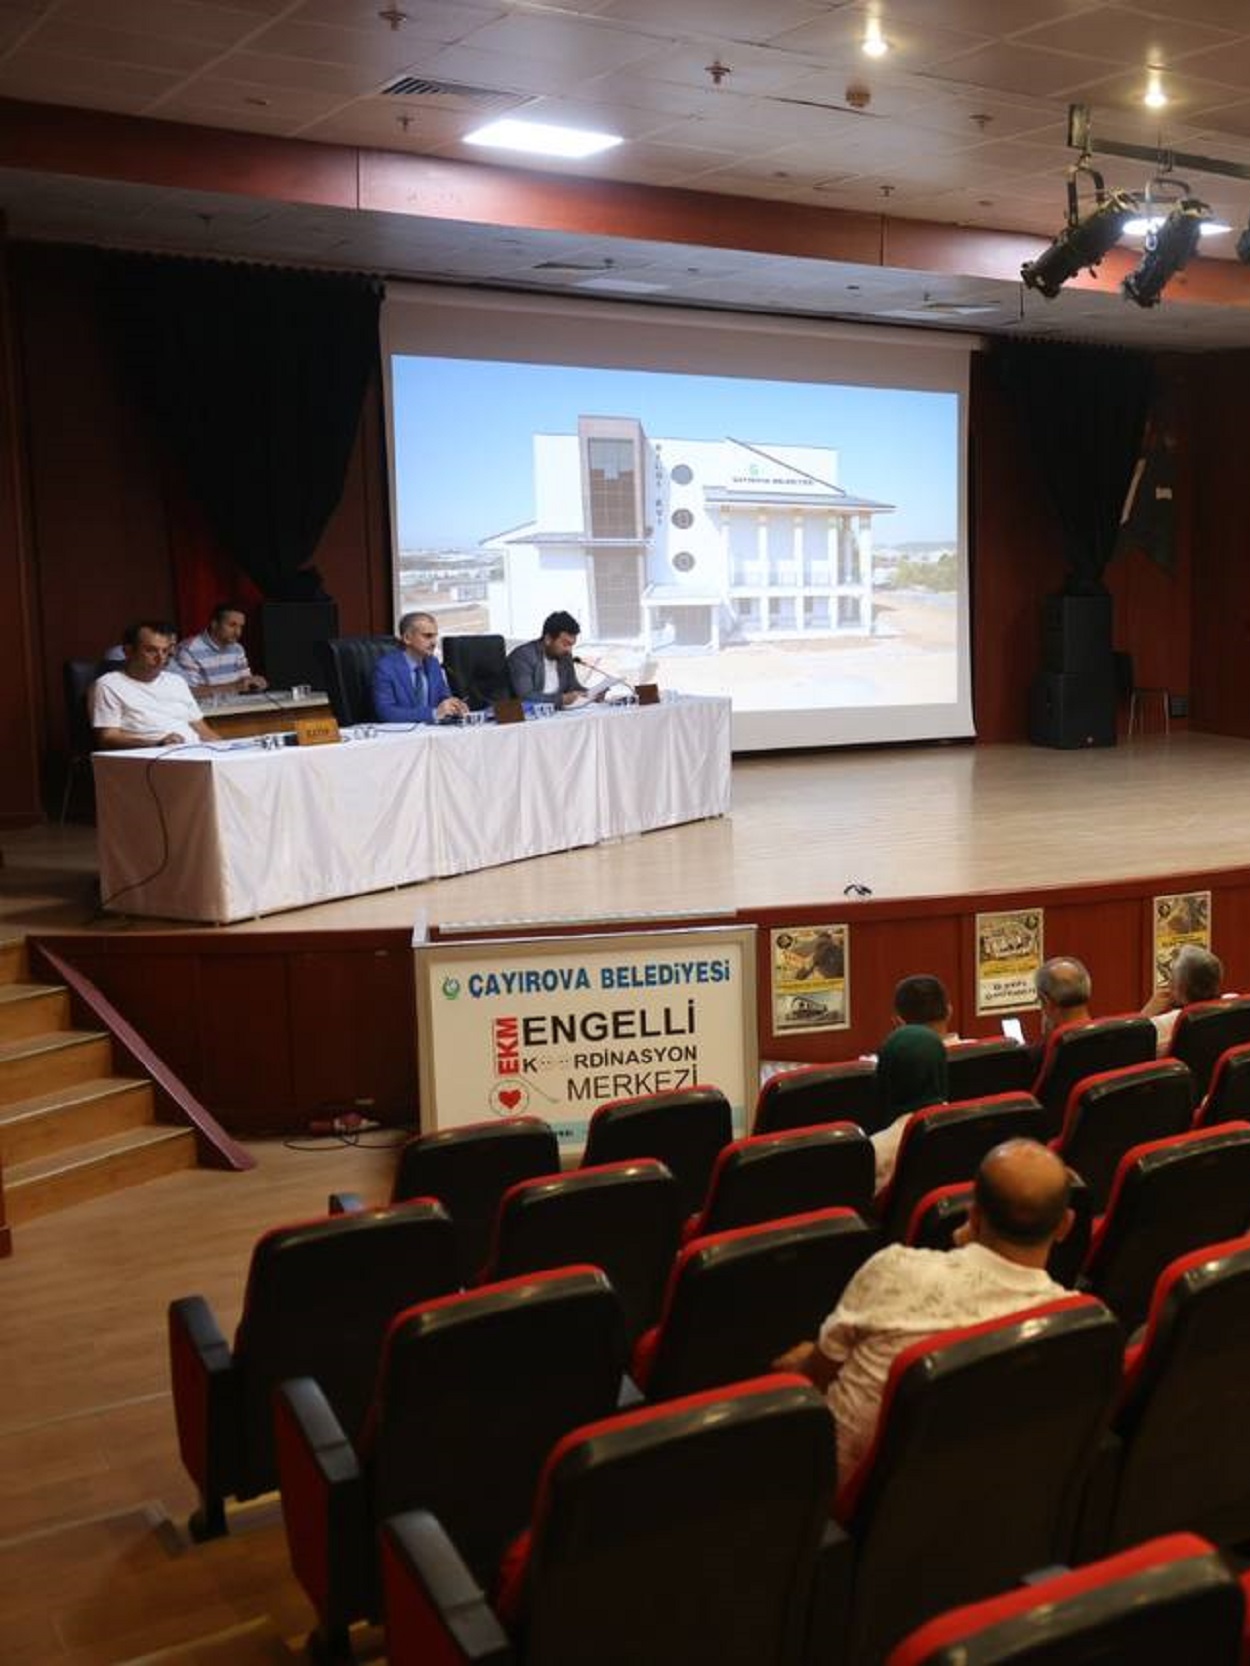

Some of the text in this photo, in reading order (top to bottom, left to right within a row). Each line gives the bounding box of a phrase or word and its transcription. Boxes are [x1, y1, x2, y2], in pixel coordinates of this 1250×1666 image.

[468, 967, 591, 999] ÇAYIROVA
[522, 999, 696, 1047] ENGELLİ
[496, 1016, 519, 1076] EKM
[522, 1045, 698, 1073] KRDİNASYON
[567, 1063, 698, 1101] MERKEZİ
